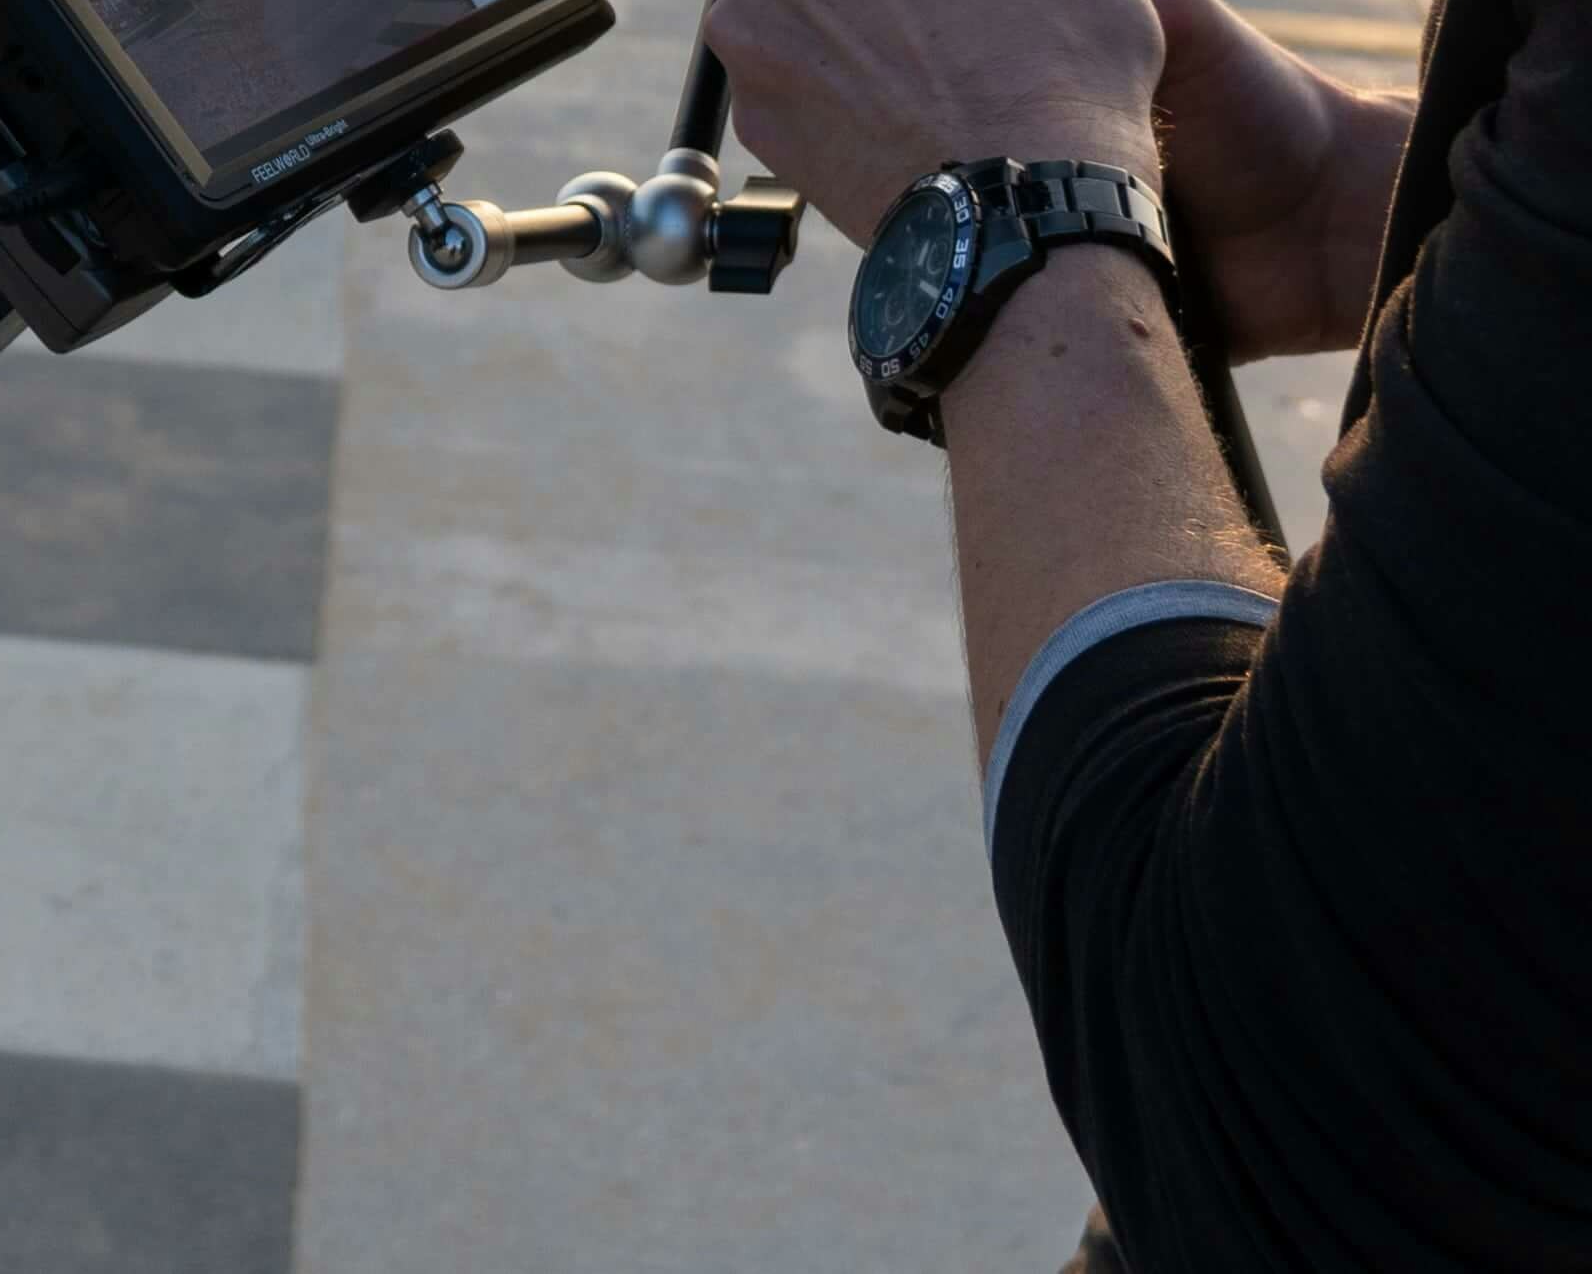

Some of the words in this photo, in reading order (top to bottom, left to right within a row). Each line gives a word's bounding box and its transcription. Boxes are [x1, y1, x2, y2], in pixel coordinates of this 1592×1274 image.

[250, 144, 311, 184] FEELWORLD
[937, 173, 958, 195] 25
[953, 195, 970, 224] 30
[953, 238, 969, 269] 35
[935, 287, 954, 320] 40
[908, 331, 931, 361] 45
[880, 357, 901, 378] 50
